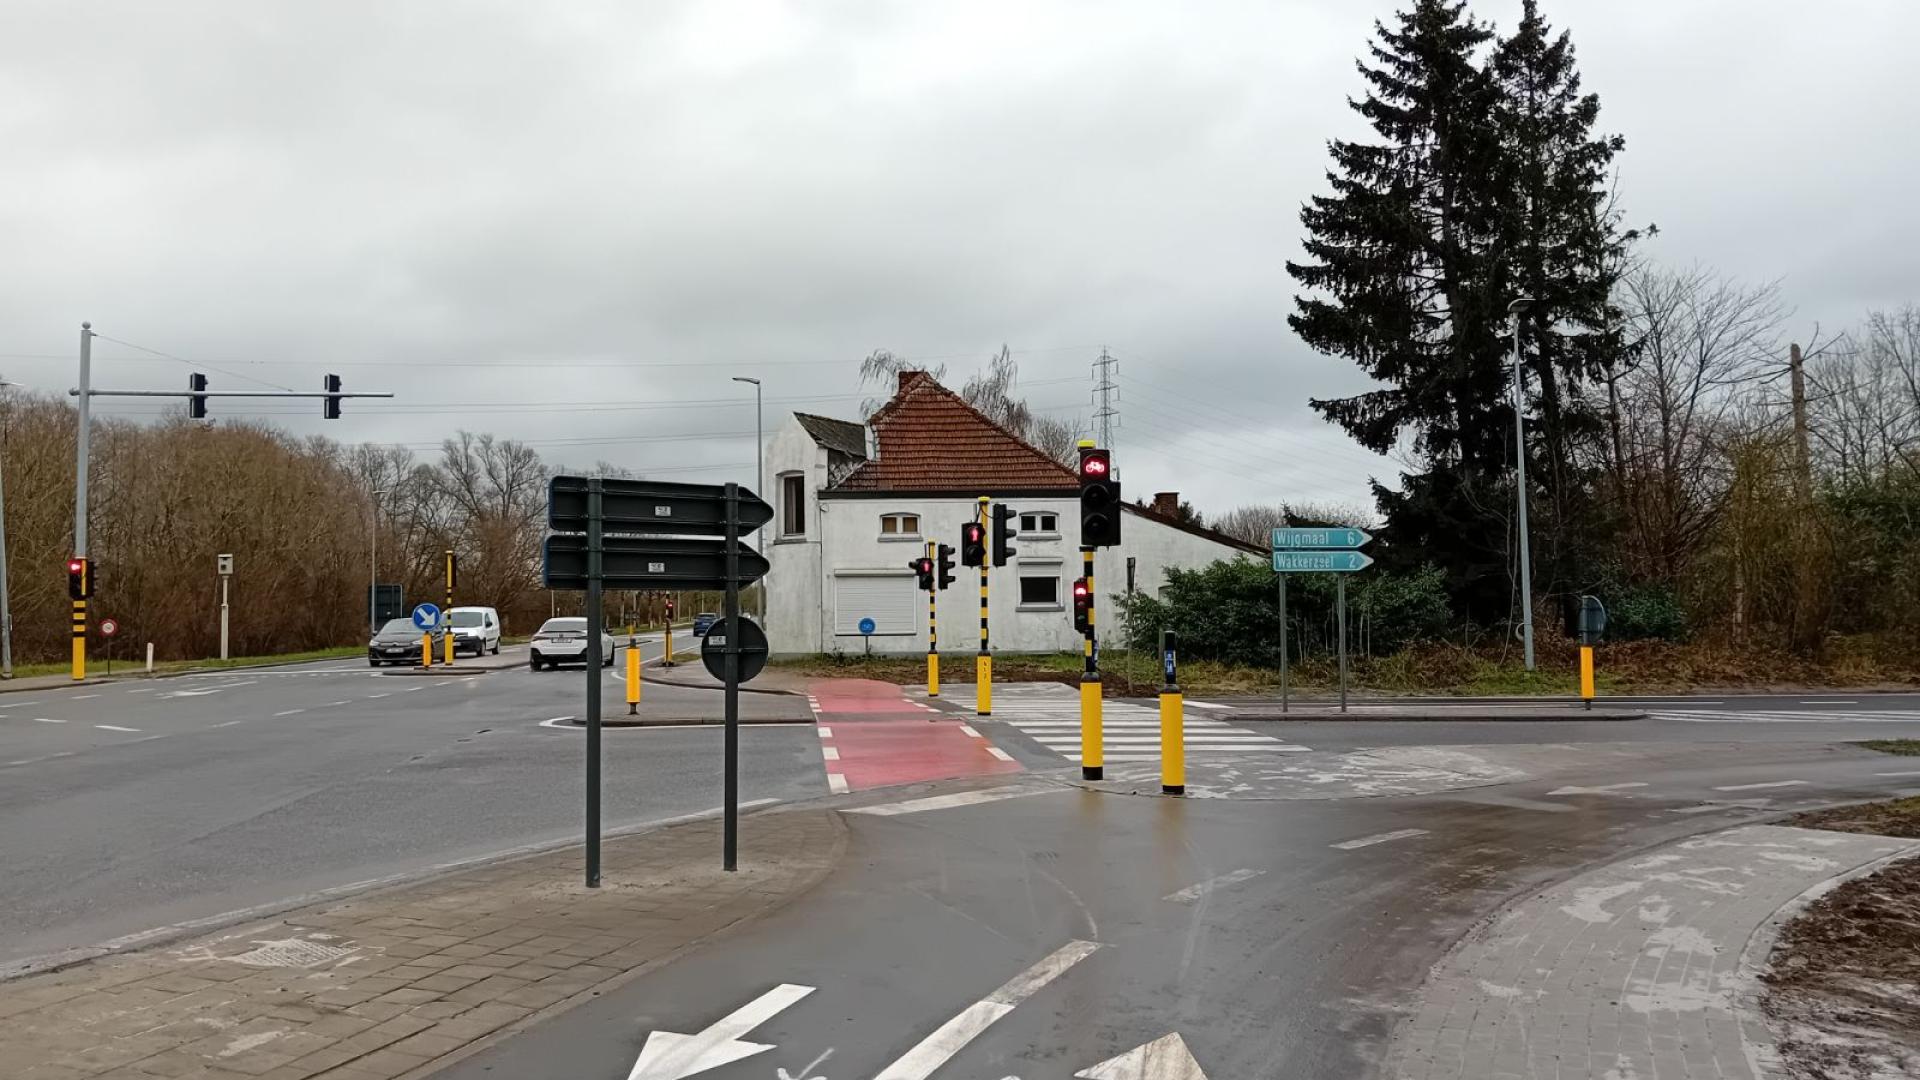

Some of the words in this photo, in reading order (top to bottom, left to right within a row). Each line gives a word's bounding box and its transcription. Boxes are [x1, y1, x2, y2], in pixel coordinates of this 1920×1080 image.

[1276, 531, 1329, 547] Wijgmaal
[1347, 532, 1355, 545] 6
[1276, 554, 1334, 568] Wakkerzeel
[1349, 555, 1356, 568] 2
